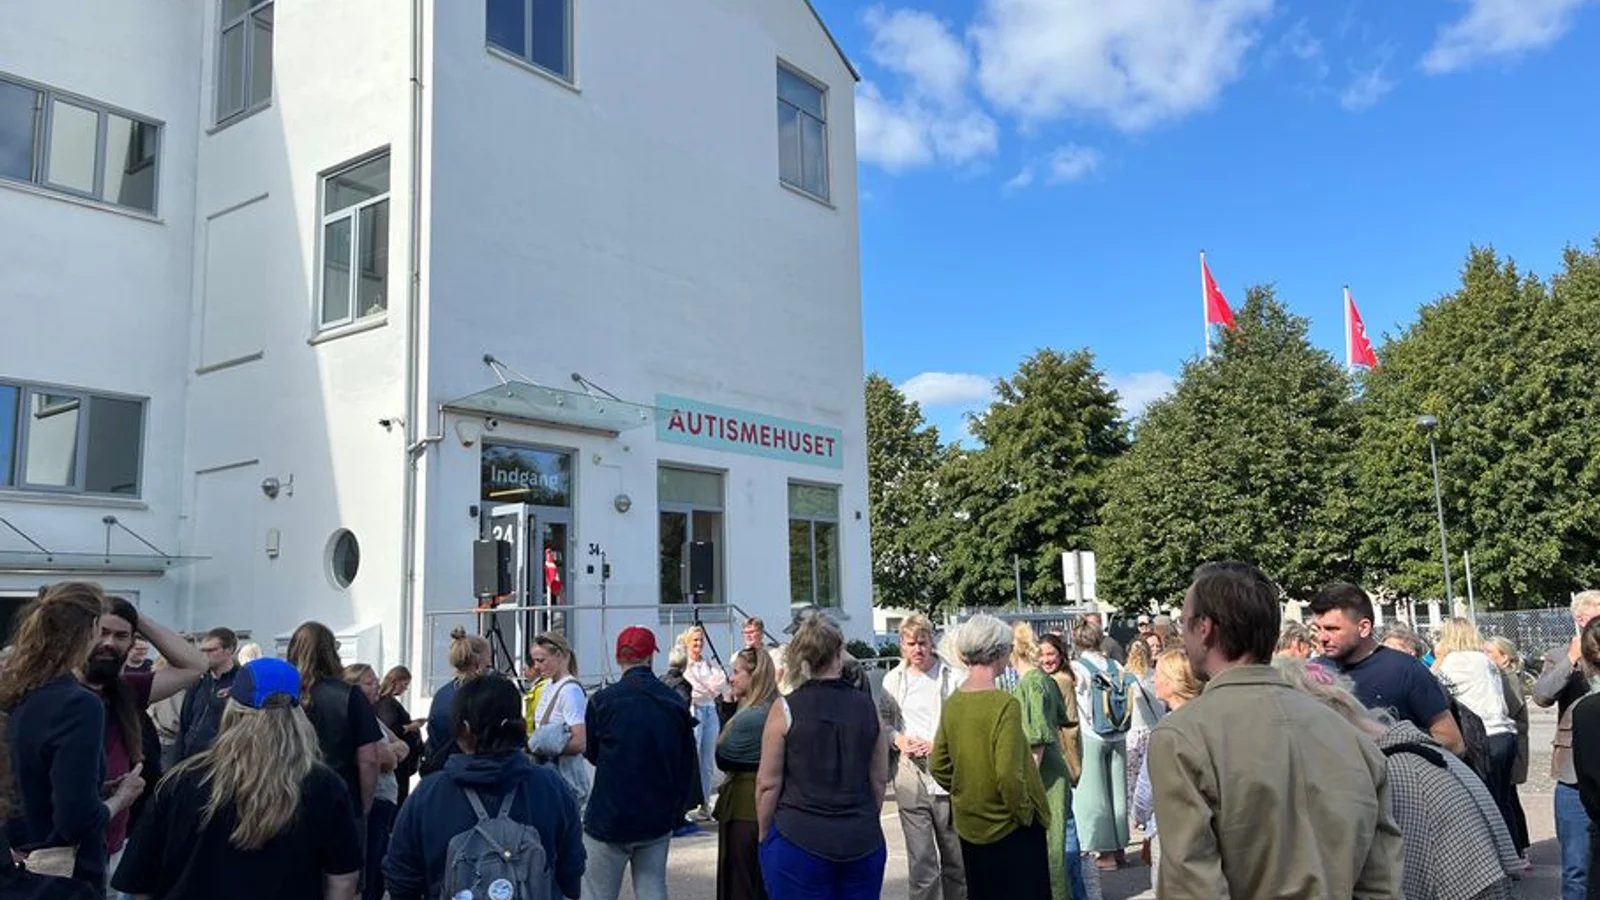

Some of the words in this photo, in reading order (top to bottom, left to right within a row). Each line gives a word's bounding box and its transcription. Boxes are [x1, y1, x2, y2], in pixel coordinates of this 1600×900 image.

[668, 409, 836, 457] AUTISMEHUSET
[491, 465, 559, 492] Indgang
[588, 543, 600, 556] 34
